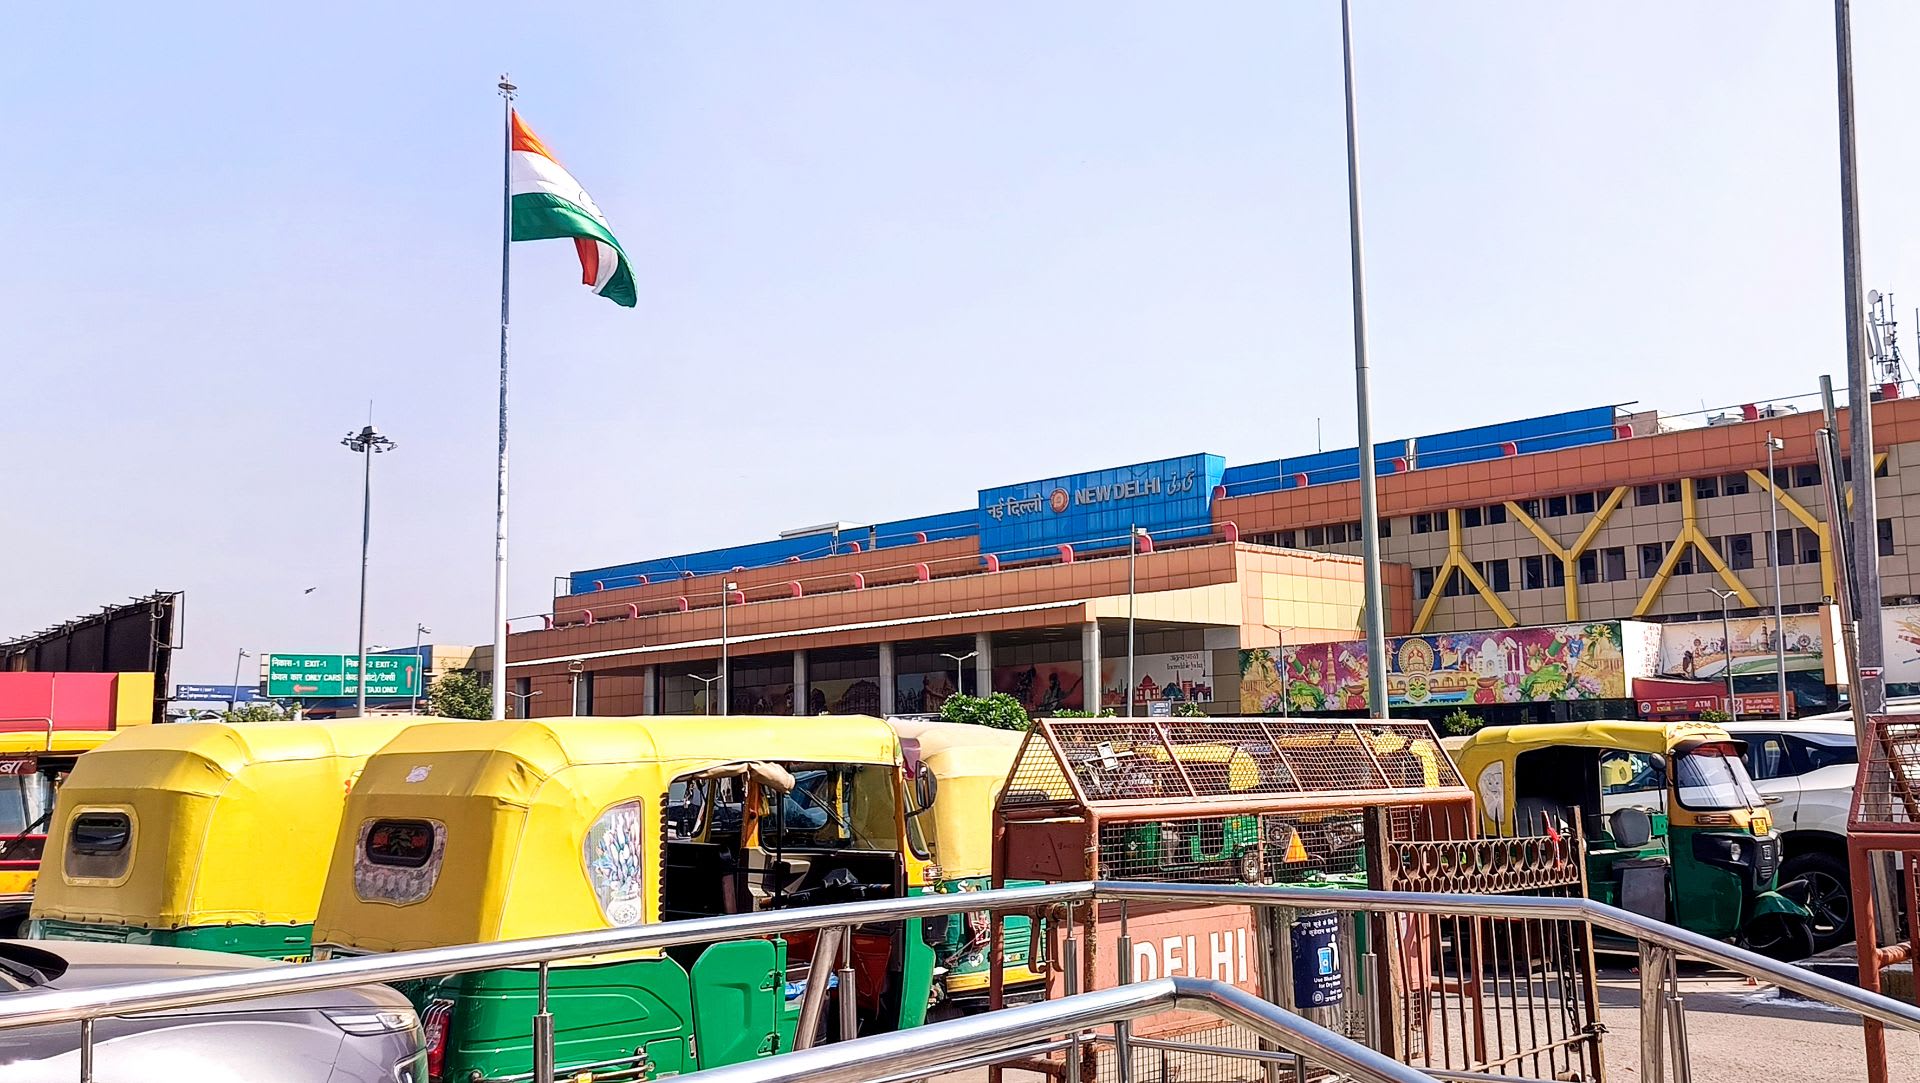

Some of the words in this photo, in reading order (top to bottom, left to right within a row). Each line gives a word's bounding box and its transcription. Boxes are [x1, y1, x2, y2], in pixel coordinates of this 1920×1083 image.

[1074, 484, 1111, 505] NEW
[1112, 476, 1161, 500] DELHI
[986, 497, 1005, 522] नई
[1006, 493, 1044, 517] दिल्ली
[304, 660, 327, 668] EXIT-1
[271, 672, 288, 681] केवल
[323, 674, 342, 682] CARS
[345, 672, 359, 682] केव
[1694, 700, 1711, 708] ATM
[1133, 927, 1248, 985] DELHI
